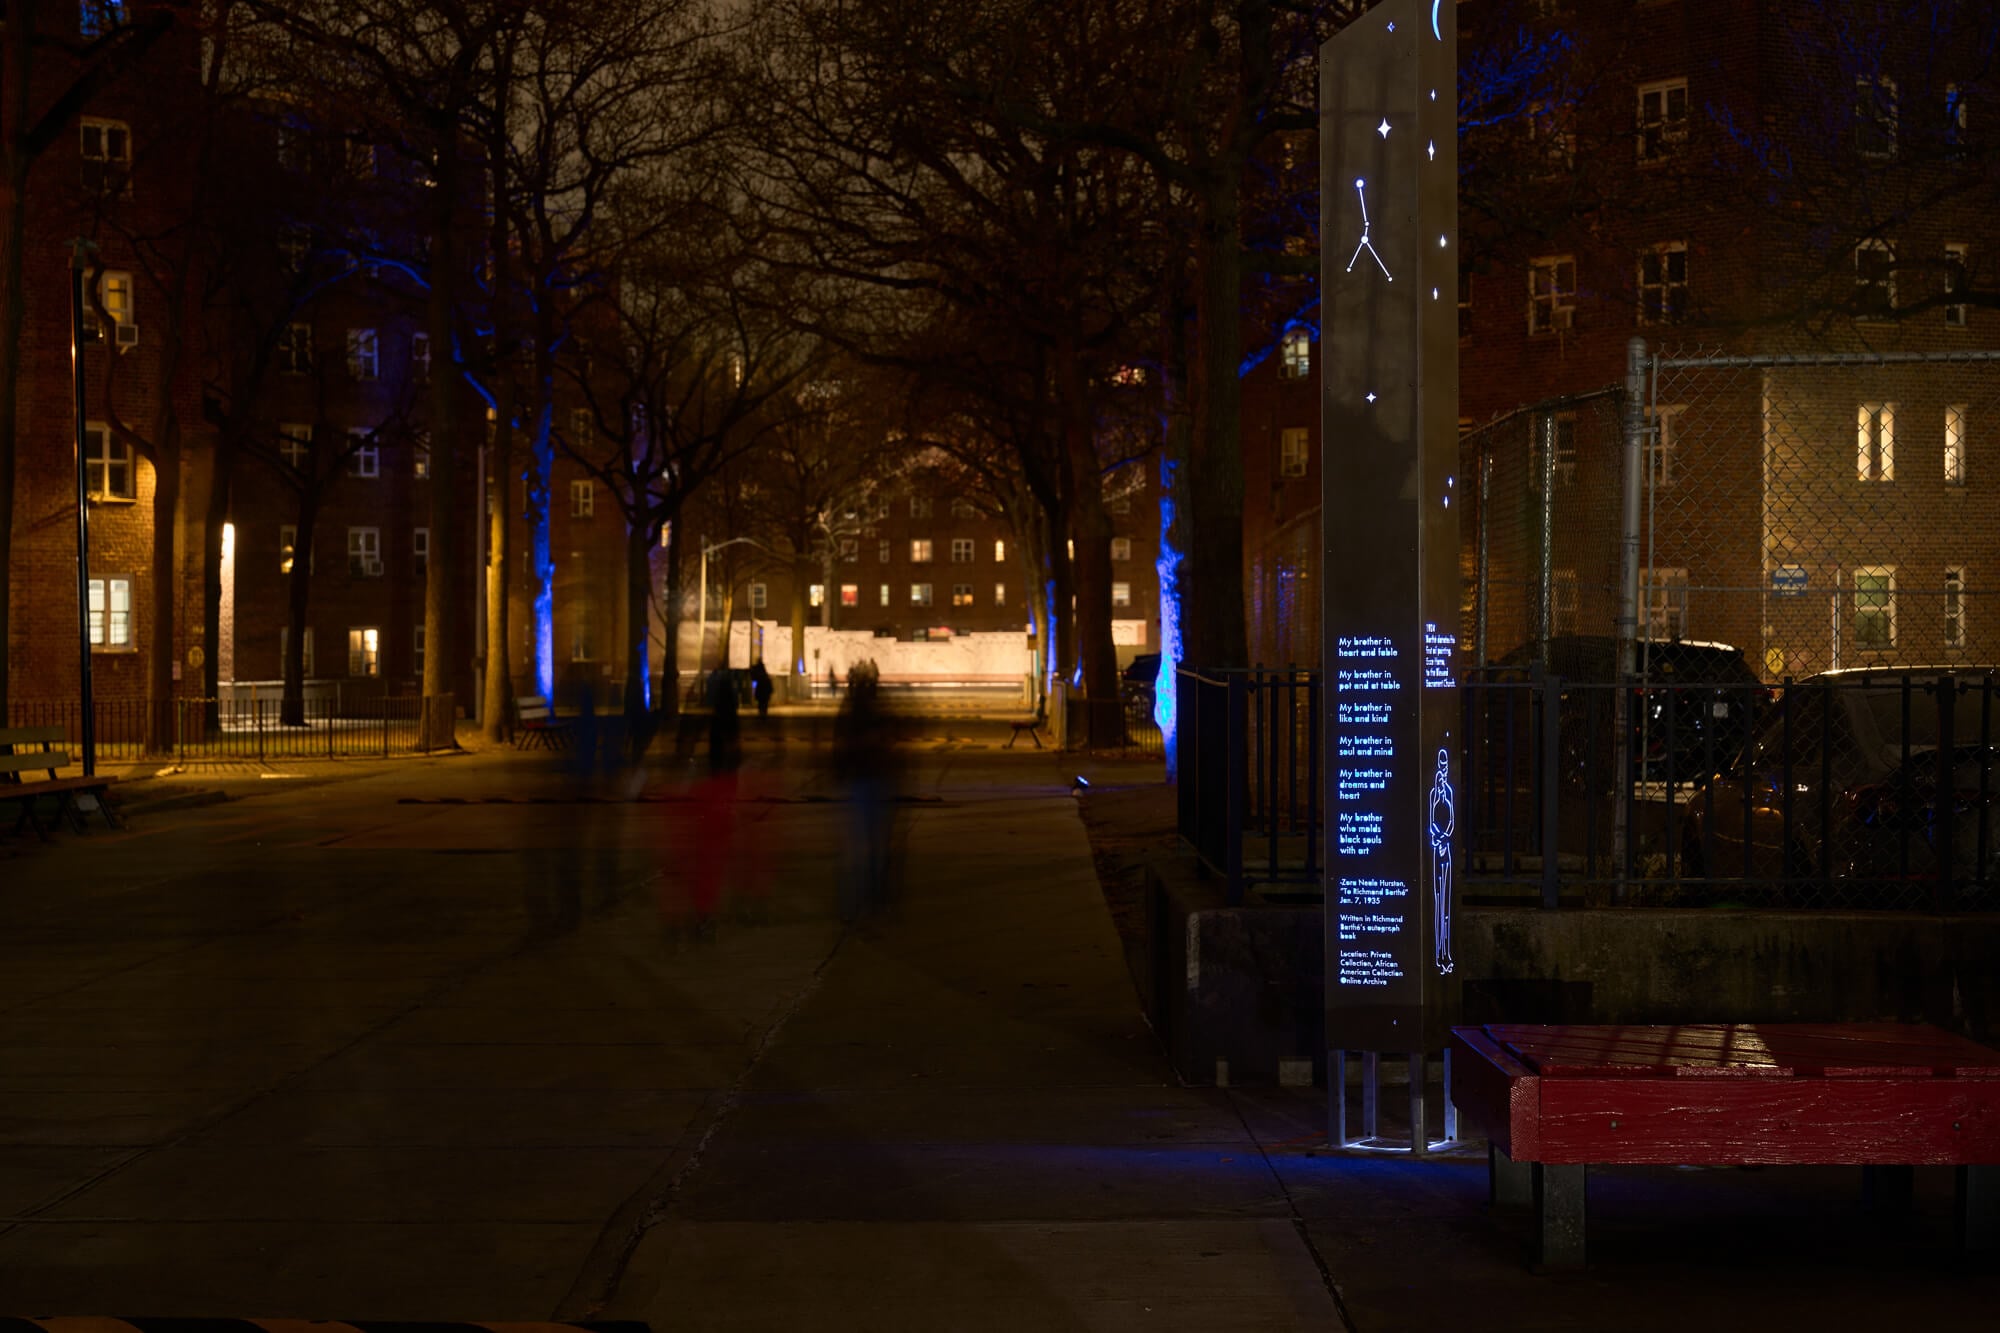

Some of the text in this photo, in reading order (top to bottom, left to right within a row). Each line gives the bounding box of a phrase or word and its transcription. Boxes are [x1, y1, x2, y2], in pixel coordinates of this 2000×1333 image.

[1354, 637, 1382, 645] brother
[1339, 648, 1398, 657] heart and fable
[1354, 670, 1382, 678] brother
[1354, 681, 1369, 690] and
[1381, 681, 1401, 690] table
[1354, 703, 1382, 712] brother
[1339, 714, 1388, 722] like and kind
[1354, 736, 1383, 745] brother
[1339, 747, 1393, 756] soul and mind
[1355, 769, 1383, 778] brother
[1340, 780, 1385, 789] dreams and
[1340, 791, 1360, 799] heart
[1355, 813, 1383, 822] brother
[1340, 824, 1381, 833] who molds
[1340, 835, 1382, 844] black souls
[1340, 846, 1369, 855] with art
[1367, 924, 1400, 932] autograph
[1375, 960, 1398, 968] African
[1372, 969, 1403, 977] Collection
[1363, 978, 1387, 986] Archive
